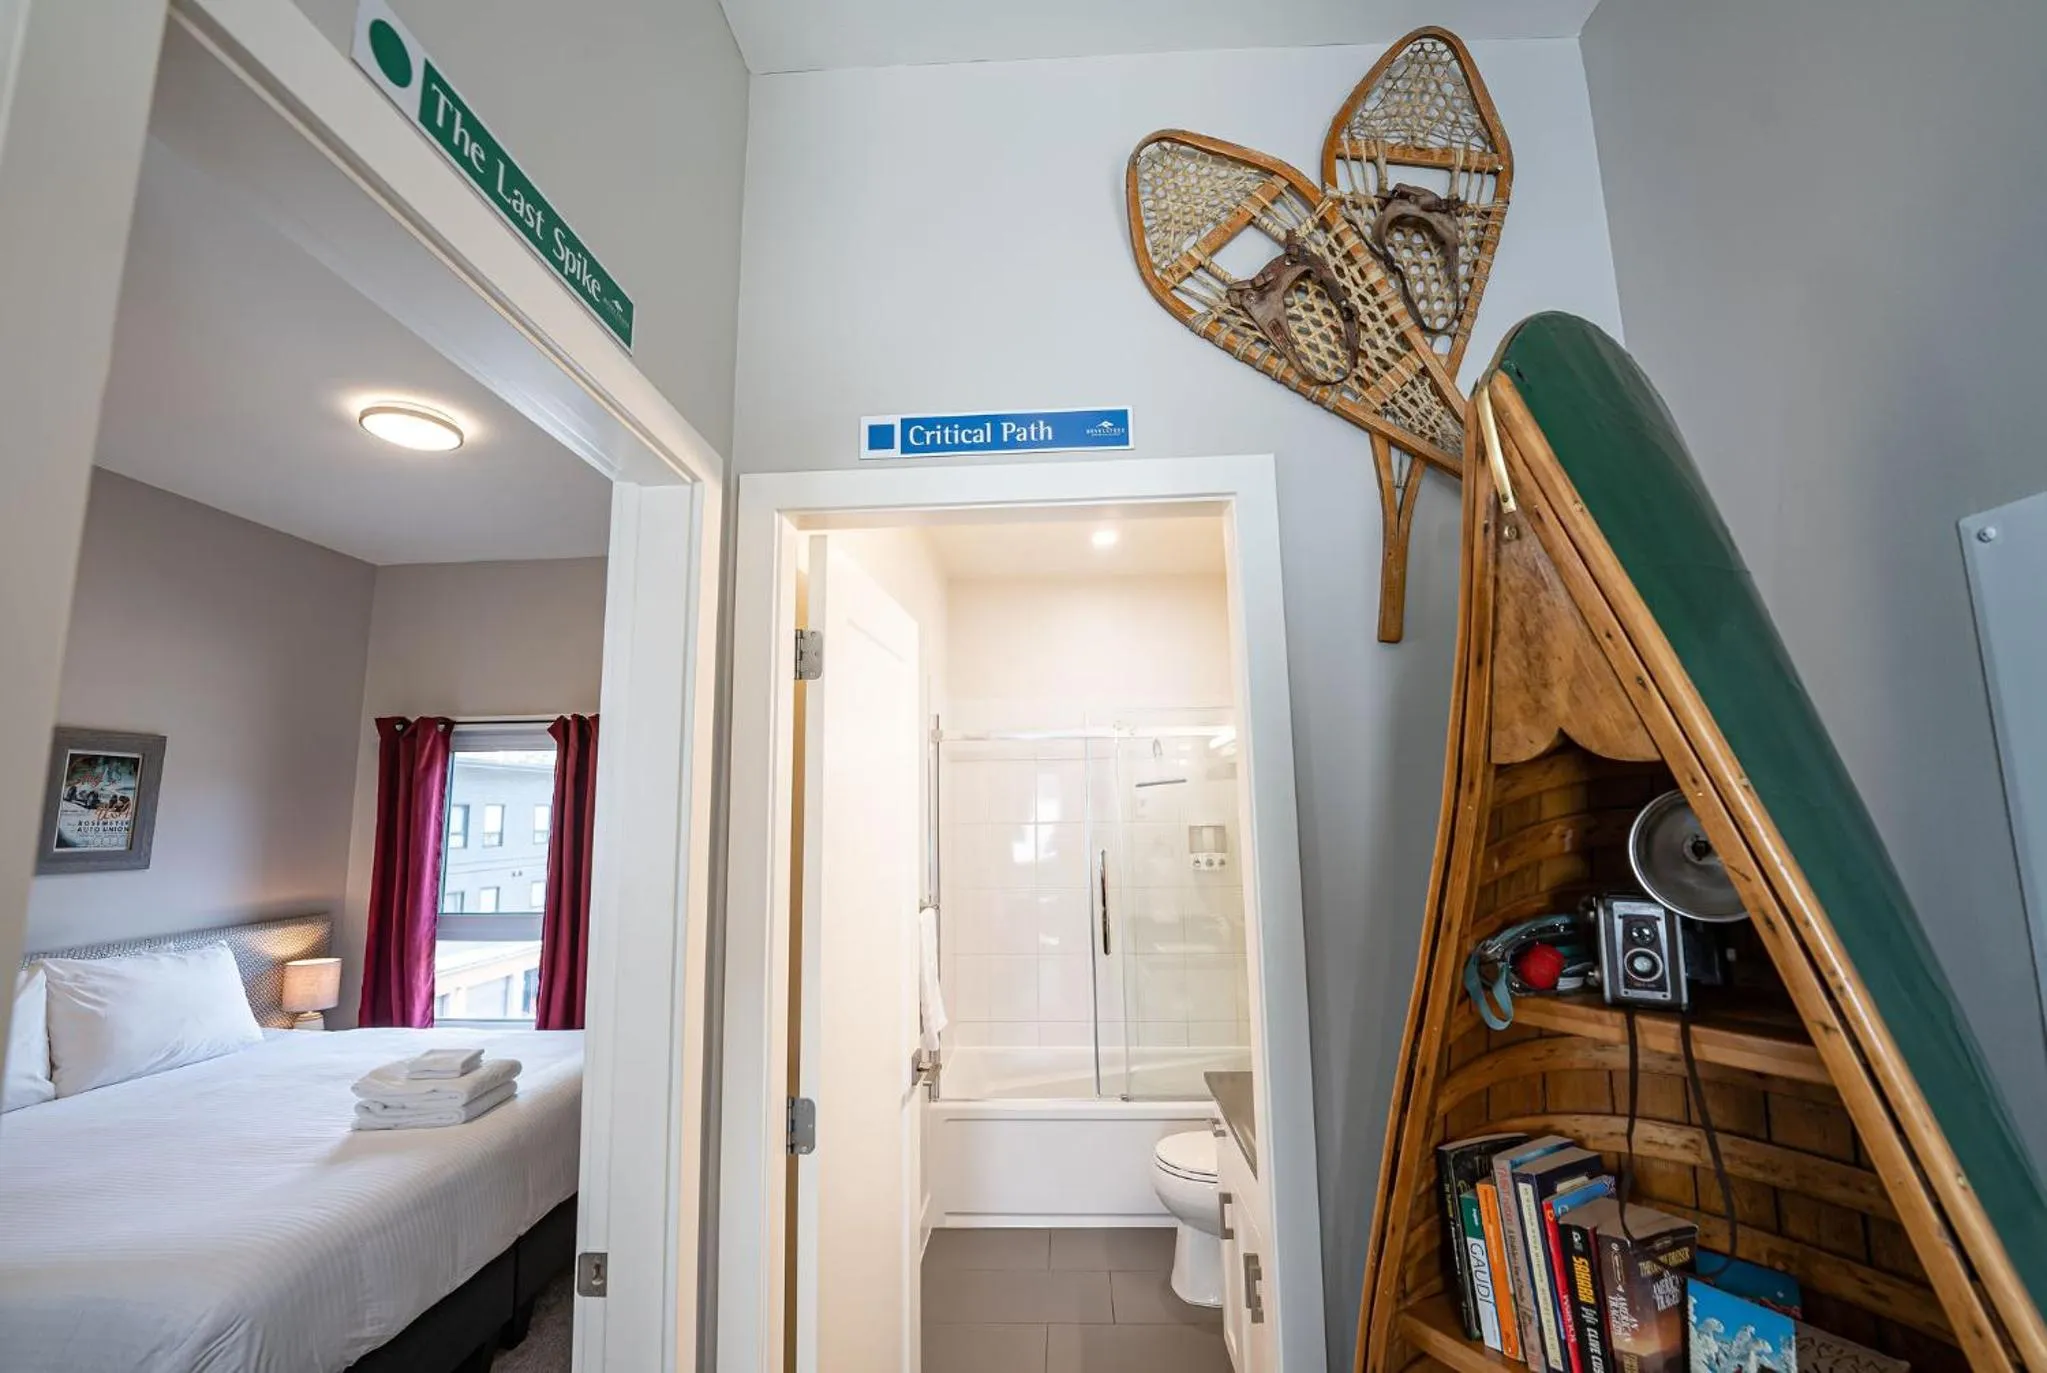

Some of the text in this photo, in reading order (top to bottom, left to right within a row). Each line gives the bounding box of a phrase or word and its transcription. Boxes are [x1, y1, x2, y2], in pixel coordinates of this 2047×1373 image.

[432, 82, 602, 303] The Last Spike
[908, 420, 1053, 446] Critical Path
[1572, 1255, 1595, 1304] SAHARA
[1586, 1327, 1602, 1356] CLIVE
